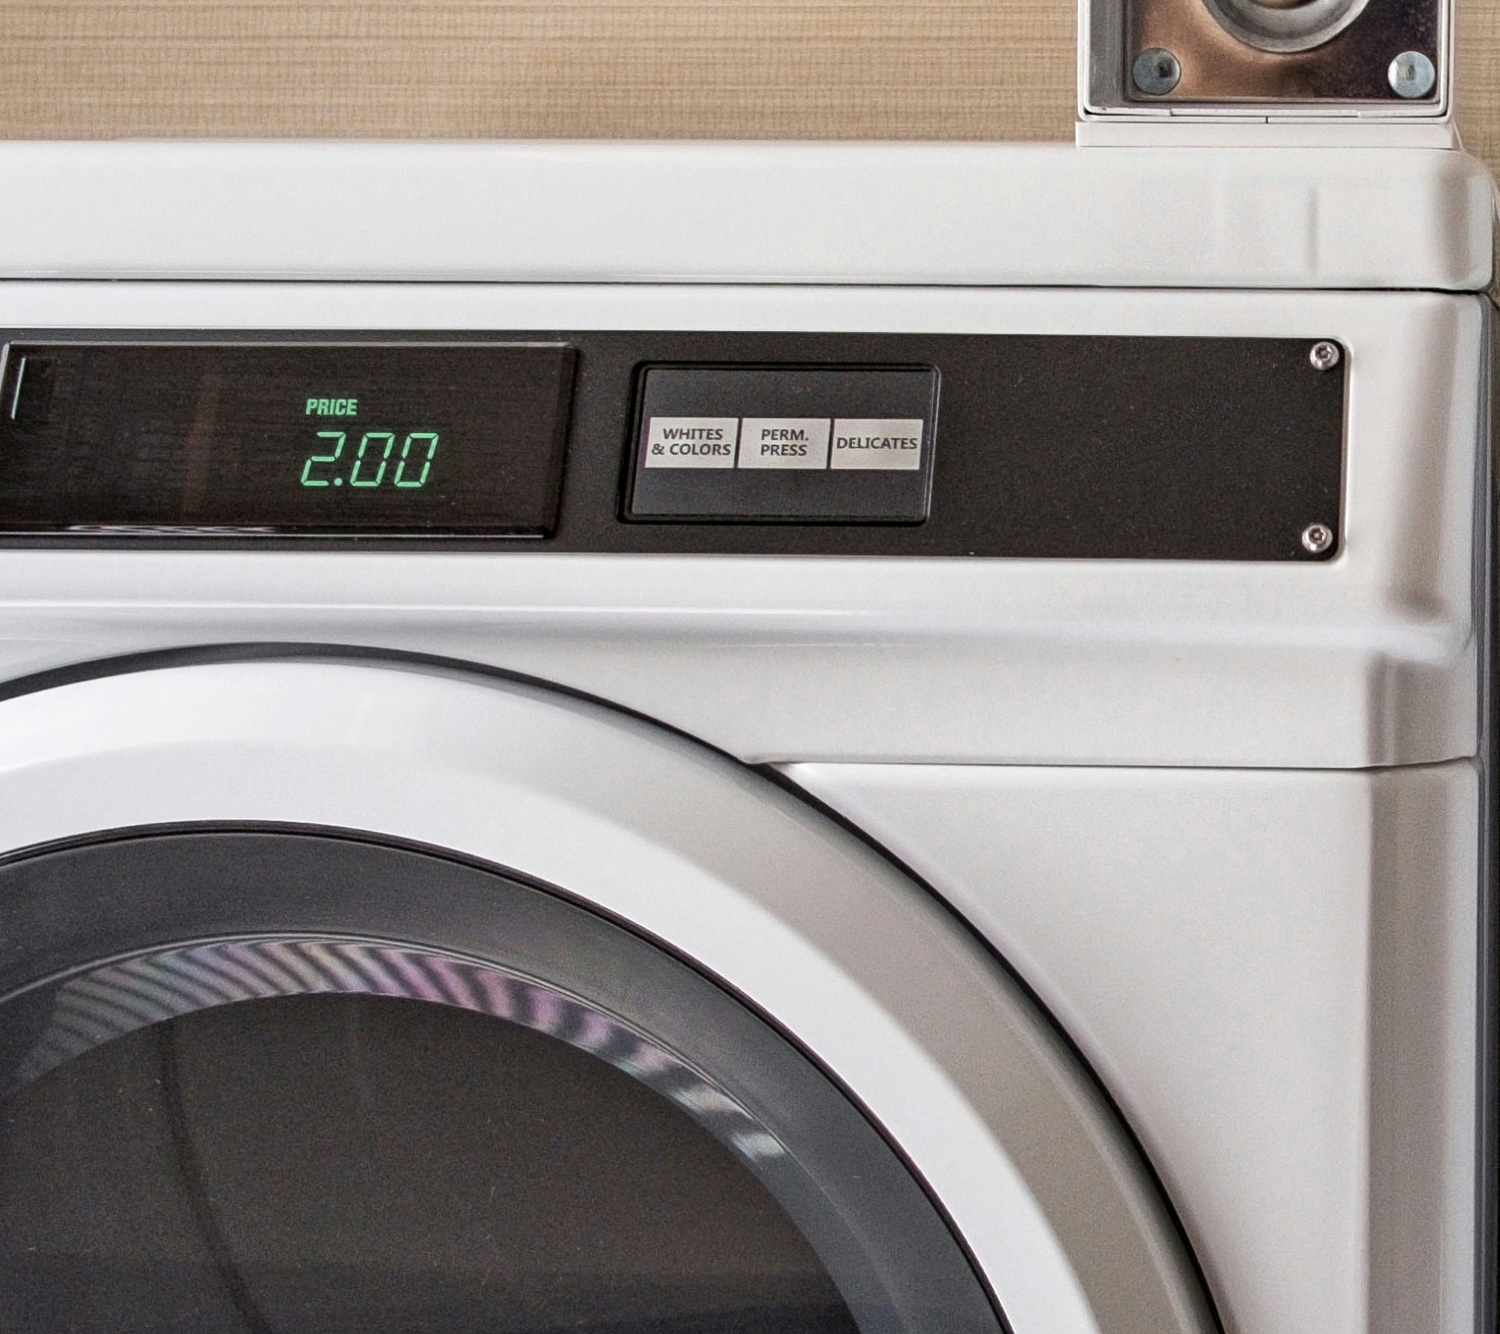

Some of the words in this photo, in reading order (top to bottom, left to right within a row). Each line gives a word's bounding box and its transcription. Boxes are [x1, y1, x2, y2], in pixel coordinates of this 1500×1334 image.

[305, 398, 358, 416] PRICE
[662, 428, 724, 441] WHITES
[761, 428, 809, 442] PERM.
[651, 443, 666, 456] &
[670, 443, 732, 457] COLORS
[760, 443, 808, 457] PRESS
[836, 436, 918, 450] DELICATES
[300, 431, 439, 487] 2.00
